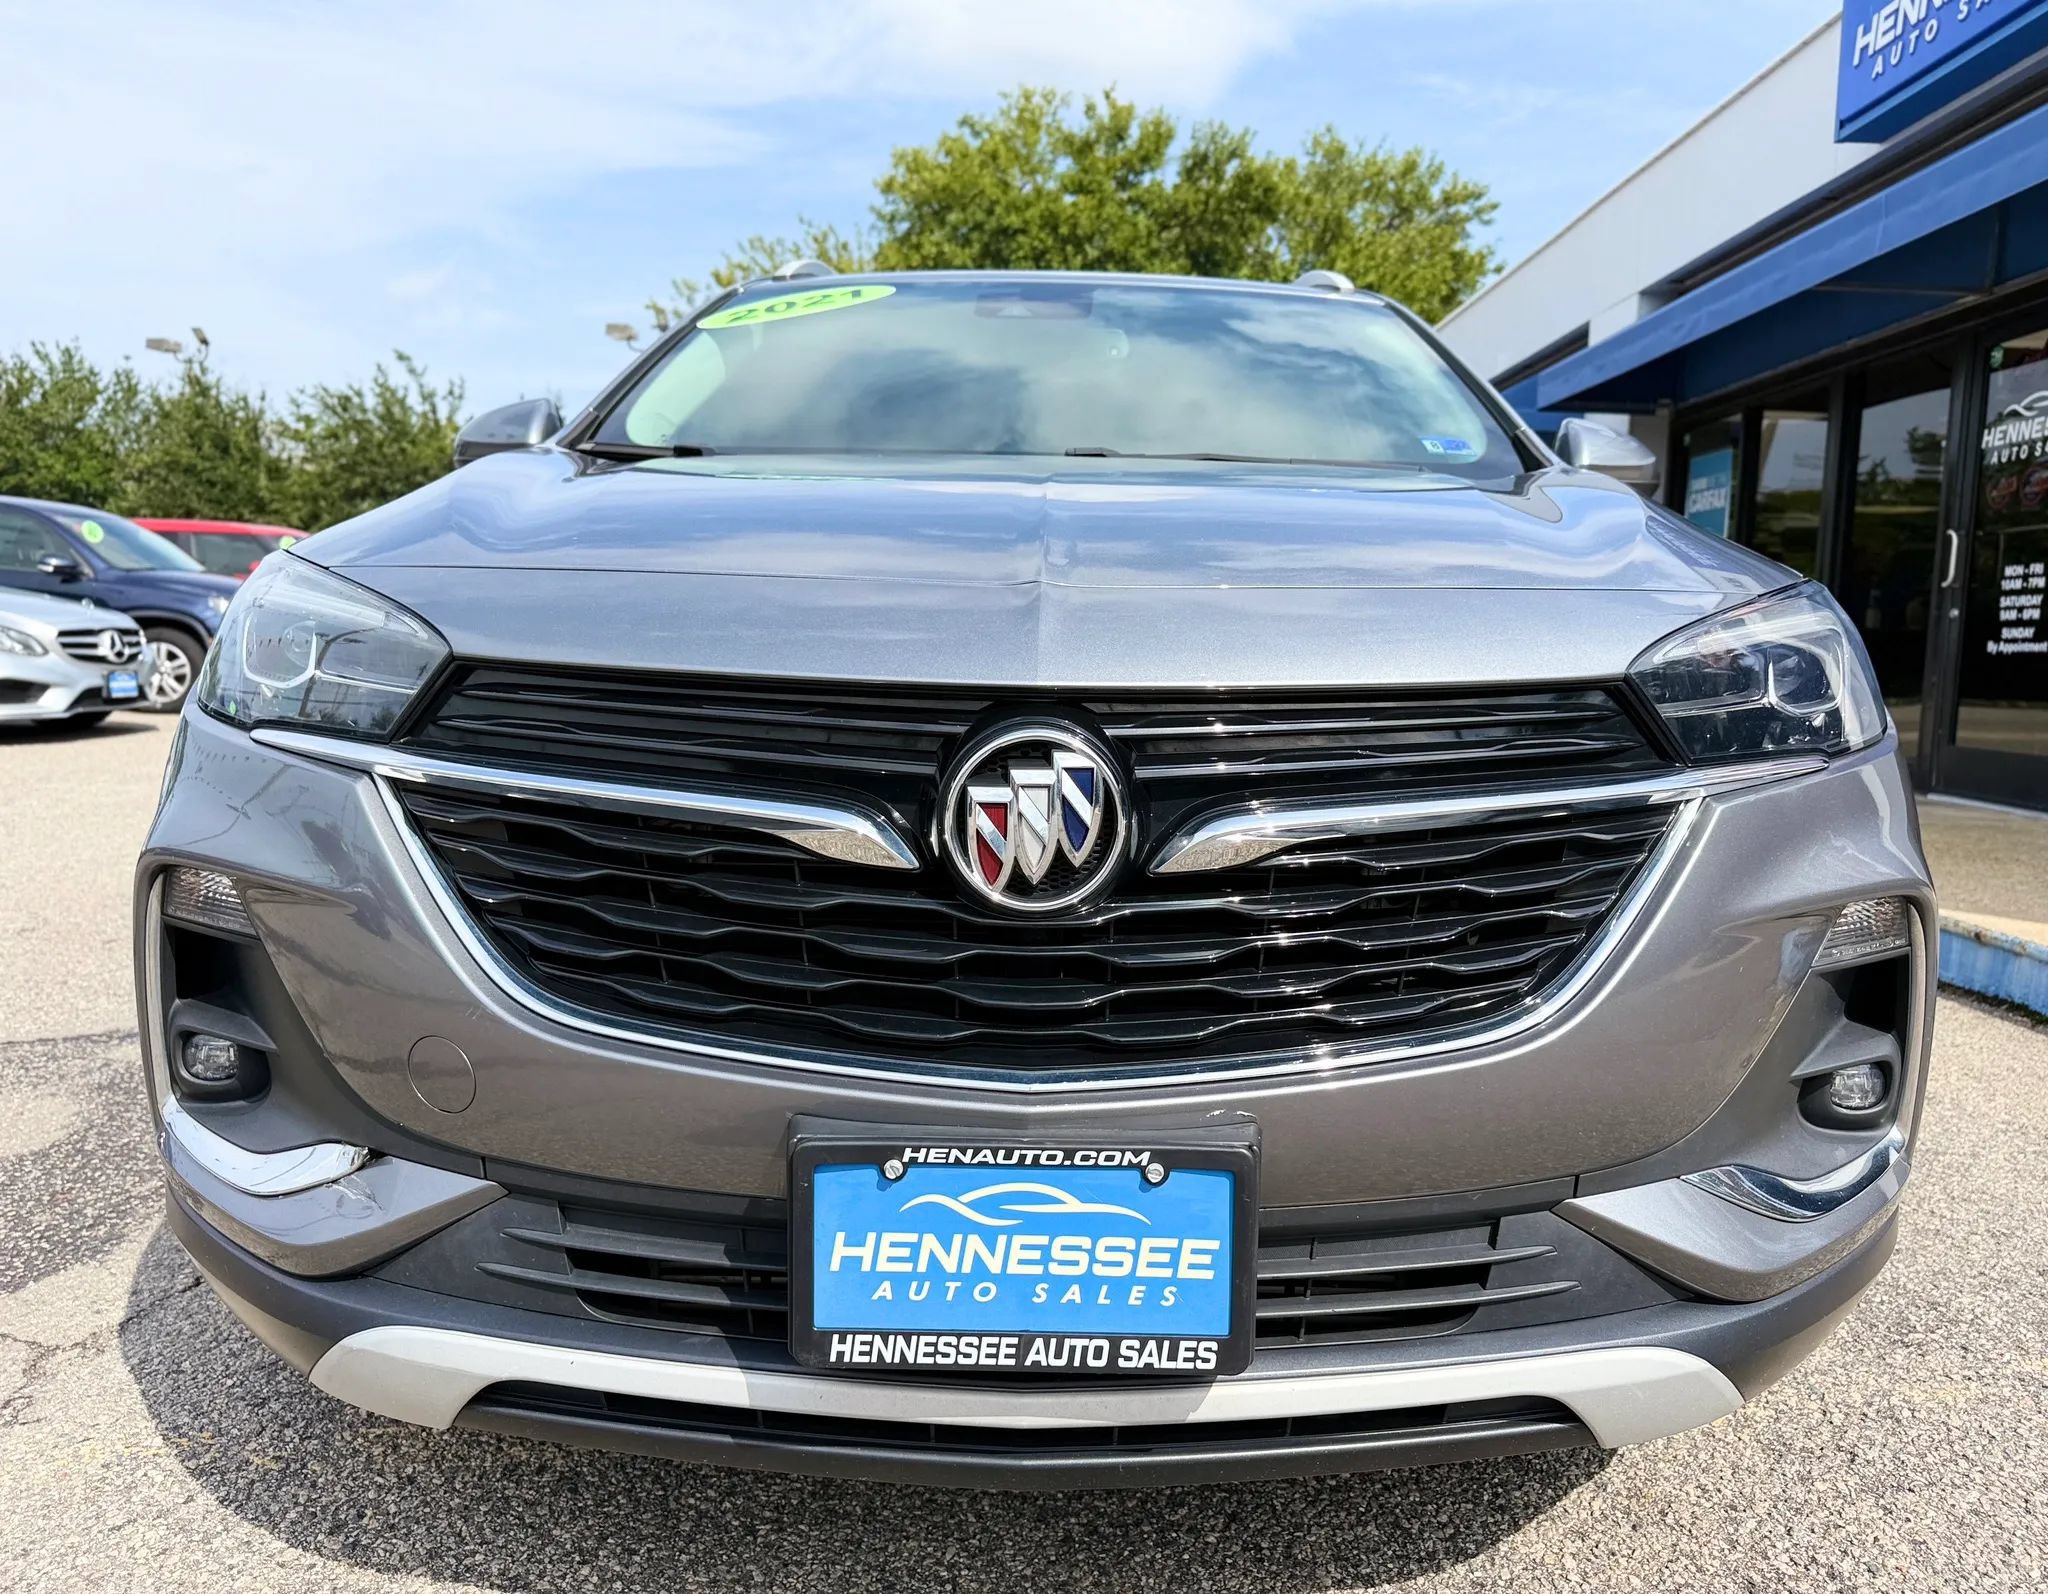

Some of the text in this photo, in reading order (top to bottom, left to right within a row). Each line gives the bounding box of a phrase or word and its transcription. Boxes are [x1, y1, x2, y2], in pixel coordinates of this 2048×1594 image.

[1853, 0, 1946, 67] HEN
[1871, 18, 1938, 80] AUTO
[727, 288, 866, 325] 2021
[1990, 440, 2048, 465] AUTO S
[2004, 564, 2024, 577] MON
[2029, 562, 2045, 576] FRI
[2000, 594, 2044, 608] SATURDAY
[2001, 626, 2036, 640] SUNDAY
[1986, 640, 2048, 655] By Appointment
[902, 1146, 1151, 1167] HENAUTO.COM
[828, 1231, 1221, 1280] HENNESSEE
[871, 1280, 1179, 1307] AUTO SALES
[829, 1333, 1218, 1370] HENNESSEE AUTO SALES
